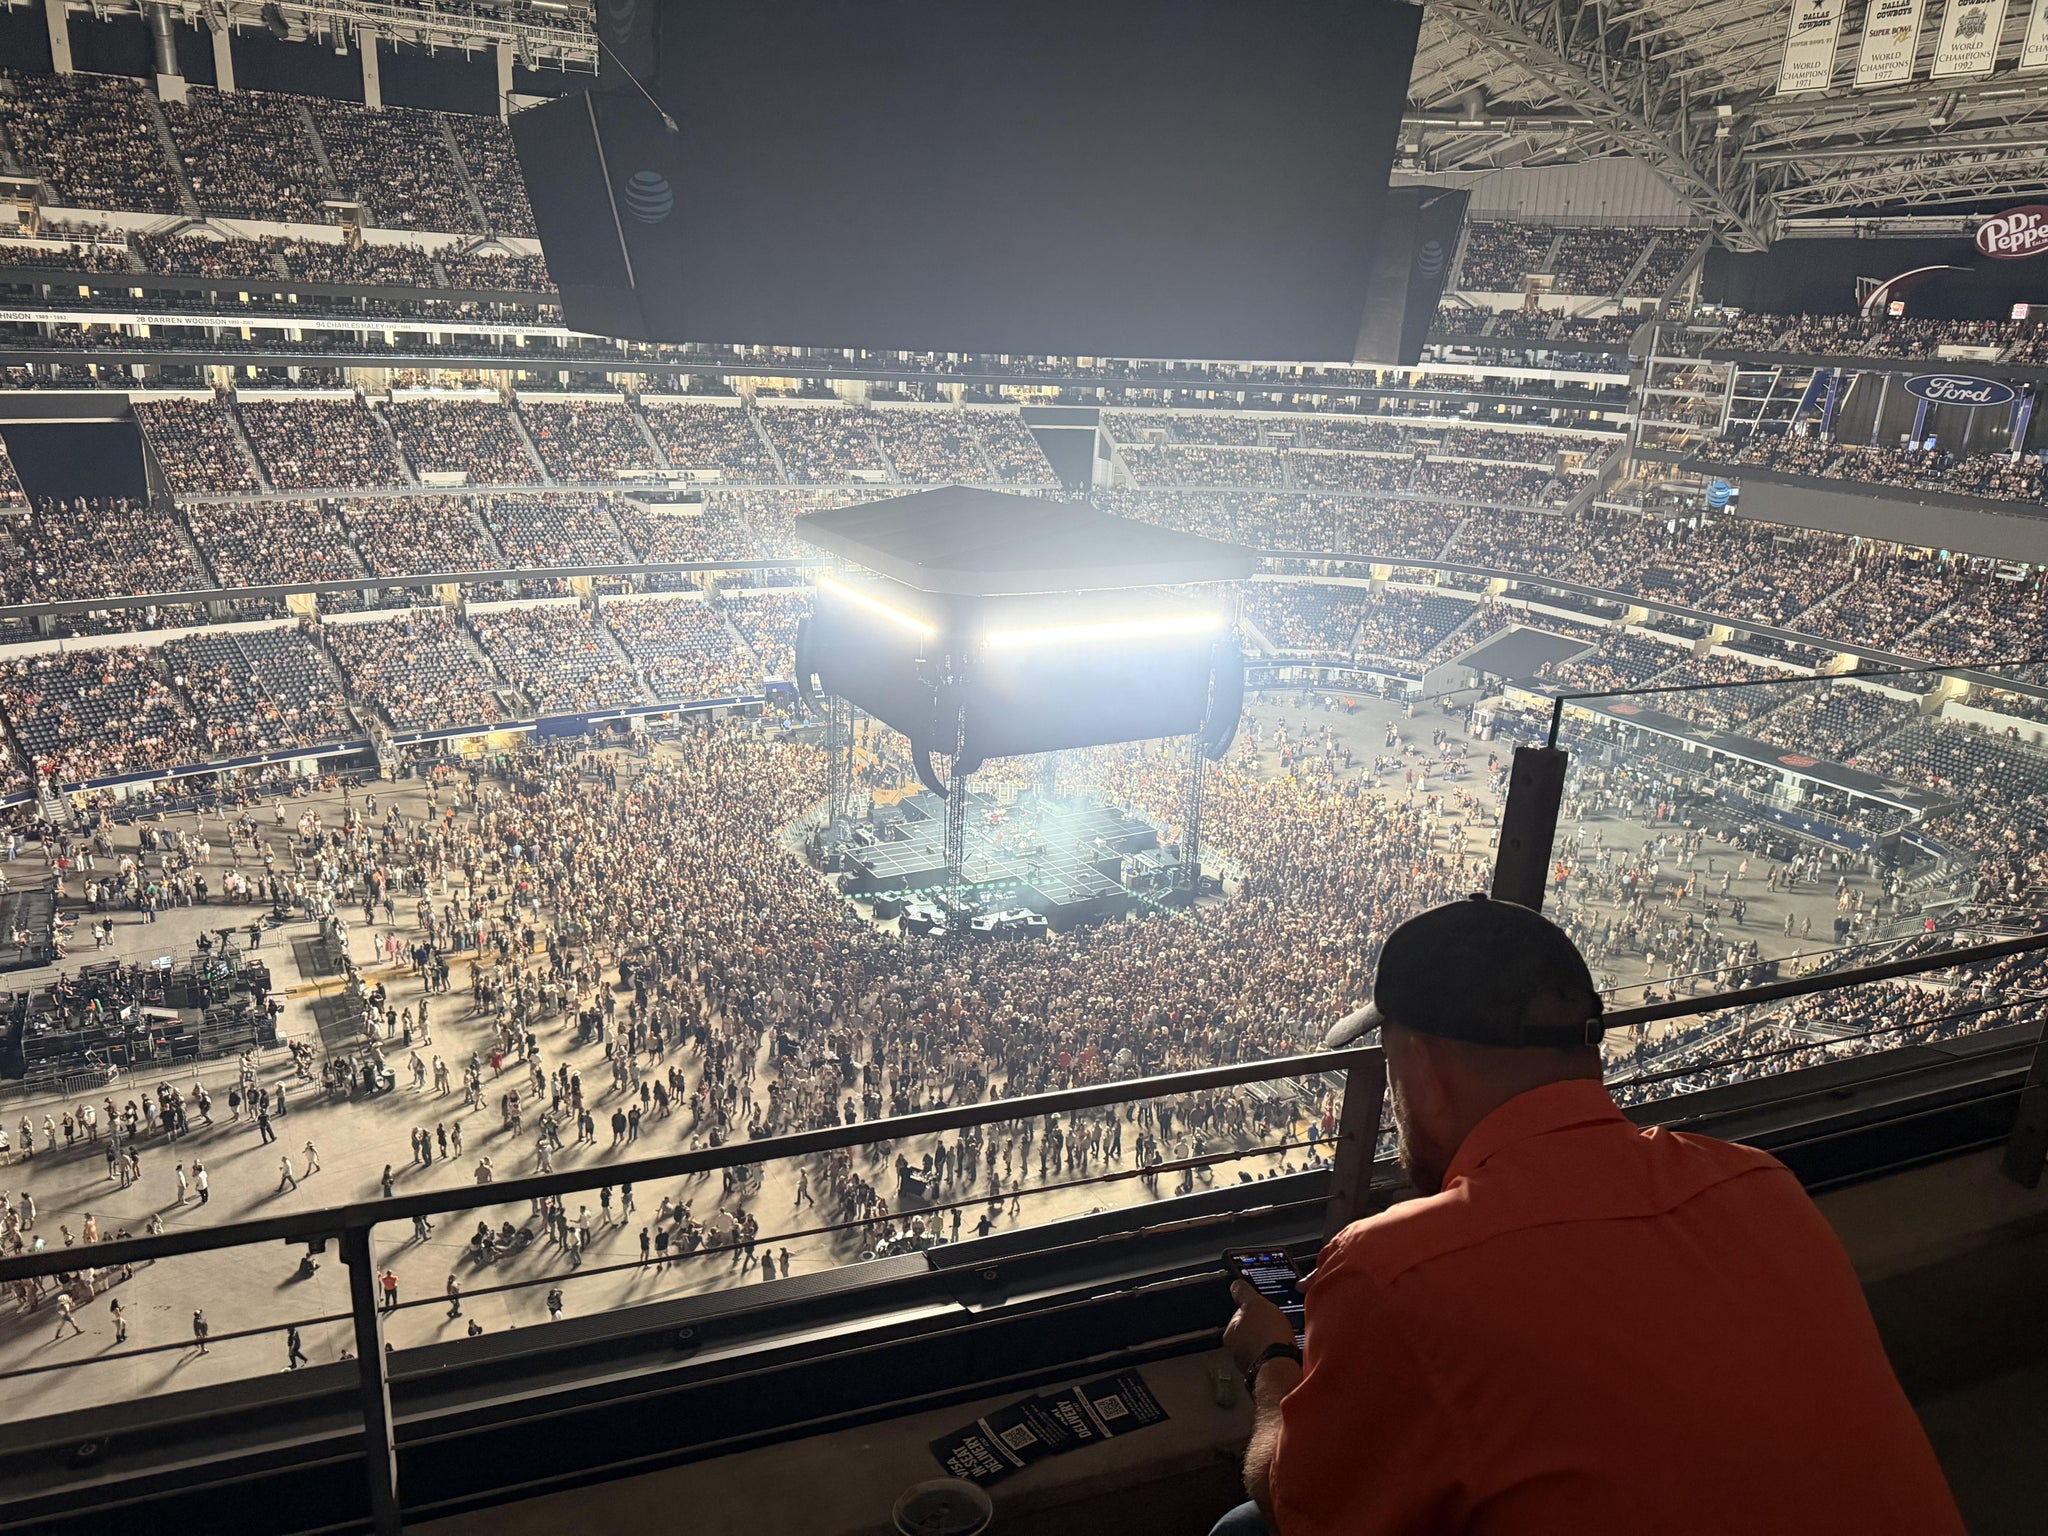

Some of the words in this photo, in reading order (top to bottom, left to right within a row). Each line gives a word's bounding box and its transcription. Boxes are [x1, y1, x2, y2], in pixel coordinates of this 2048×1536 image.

[1882, 0, 1911, 10] DALLAS
[1803, 11, 1830, 20] DALLAS
[1876, 7, 1912, 19] COWBOYS
[1798, 20, 1831, 29] COWBOYS
[1869, 28, 1891, 37] SUPER
[1892, 25, 1912, 34] BOWL
[1951, 42, 1984, 51] WORLD
[1872, 51, 1902, 61] WORLD
[1938, 51, 1991, 62] CHAMPIONS
[1793, 61, 1821, 70] WORLD
[1860, 60, 1909, 72] CHAMPIONS
[1954, 61, 1973, 71] 1992
[1783, 69, 1828, 80] CHAMPIONS
[1874, 70, 1893, 80] 1977
[1796, 79, 1812, 88] 1971
[2007, 213, 2042, 235] Dr
[1925, 377, 1992, 402] Ford
[1056, 1400, 1092, 1438] DELIVERY
[962, 1435, 1004, 1473] DELIVERY
[952, 1445, 988, 1477] IN-SEAT
[946, 1456, 969, 1478] VISA
